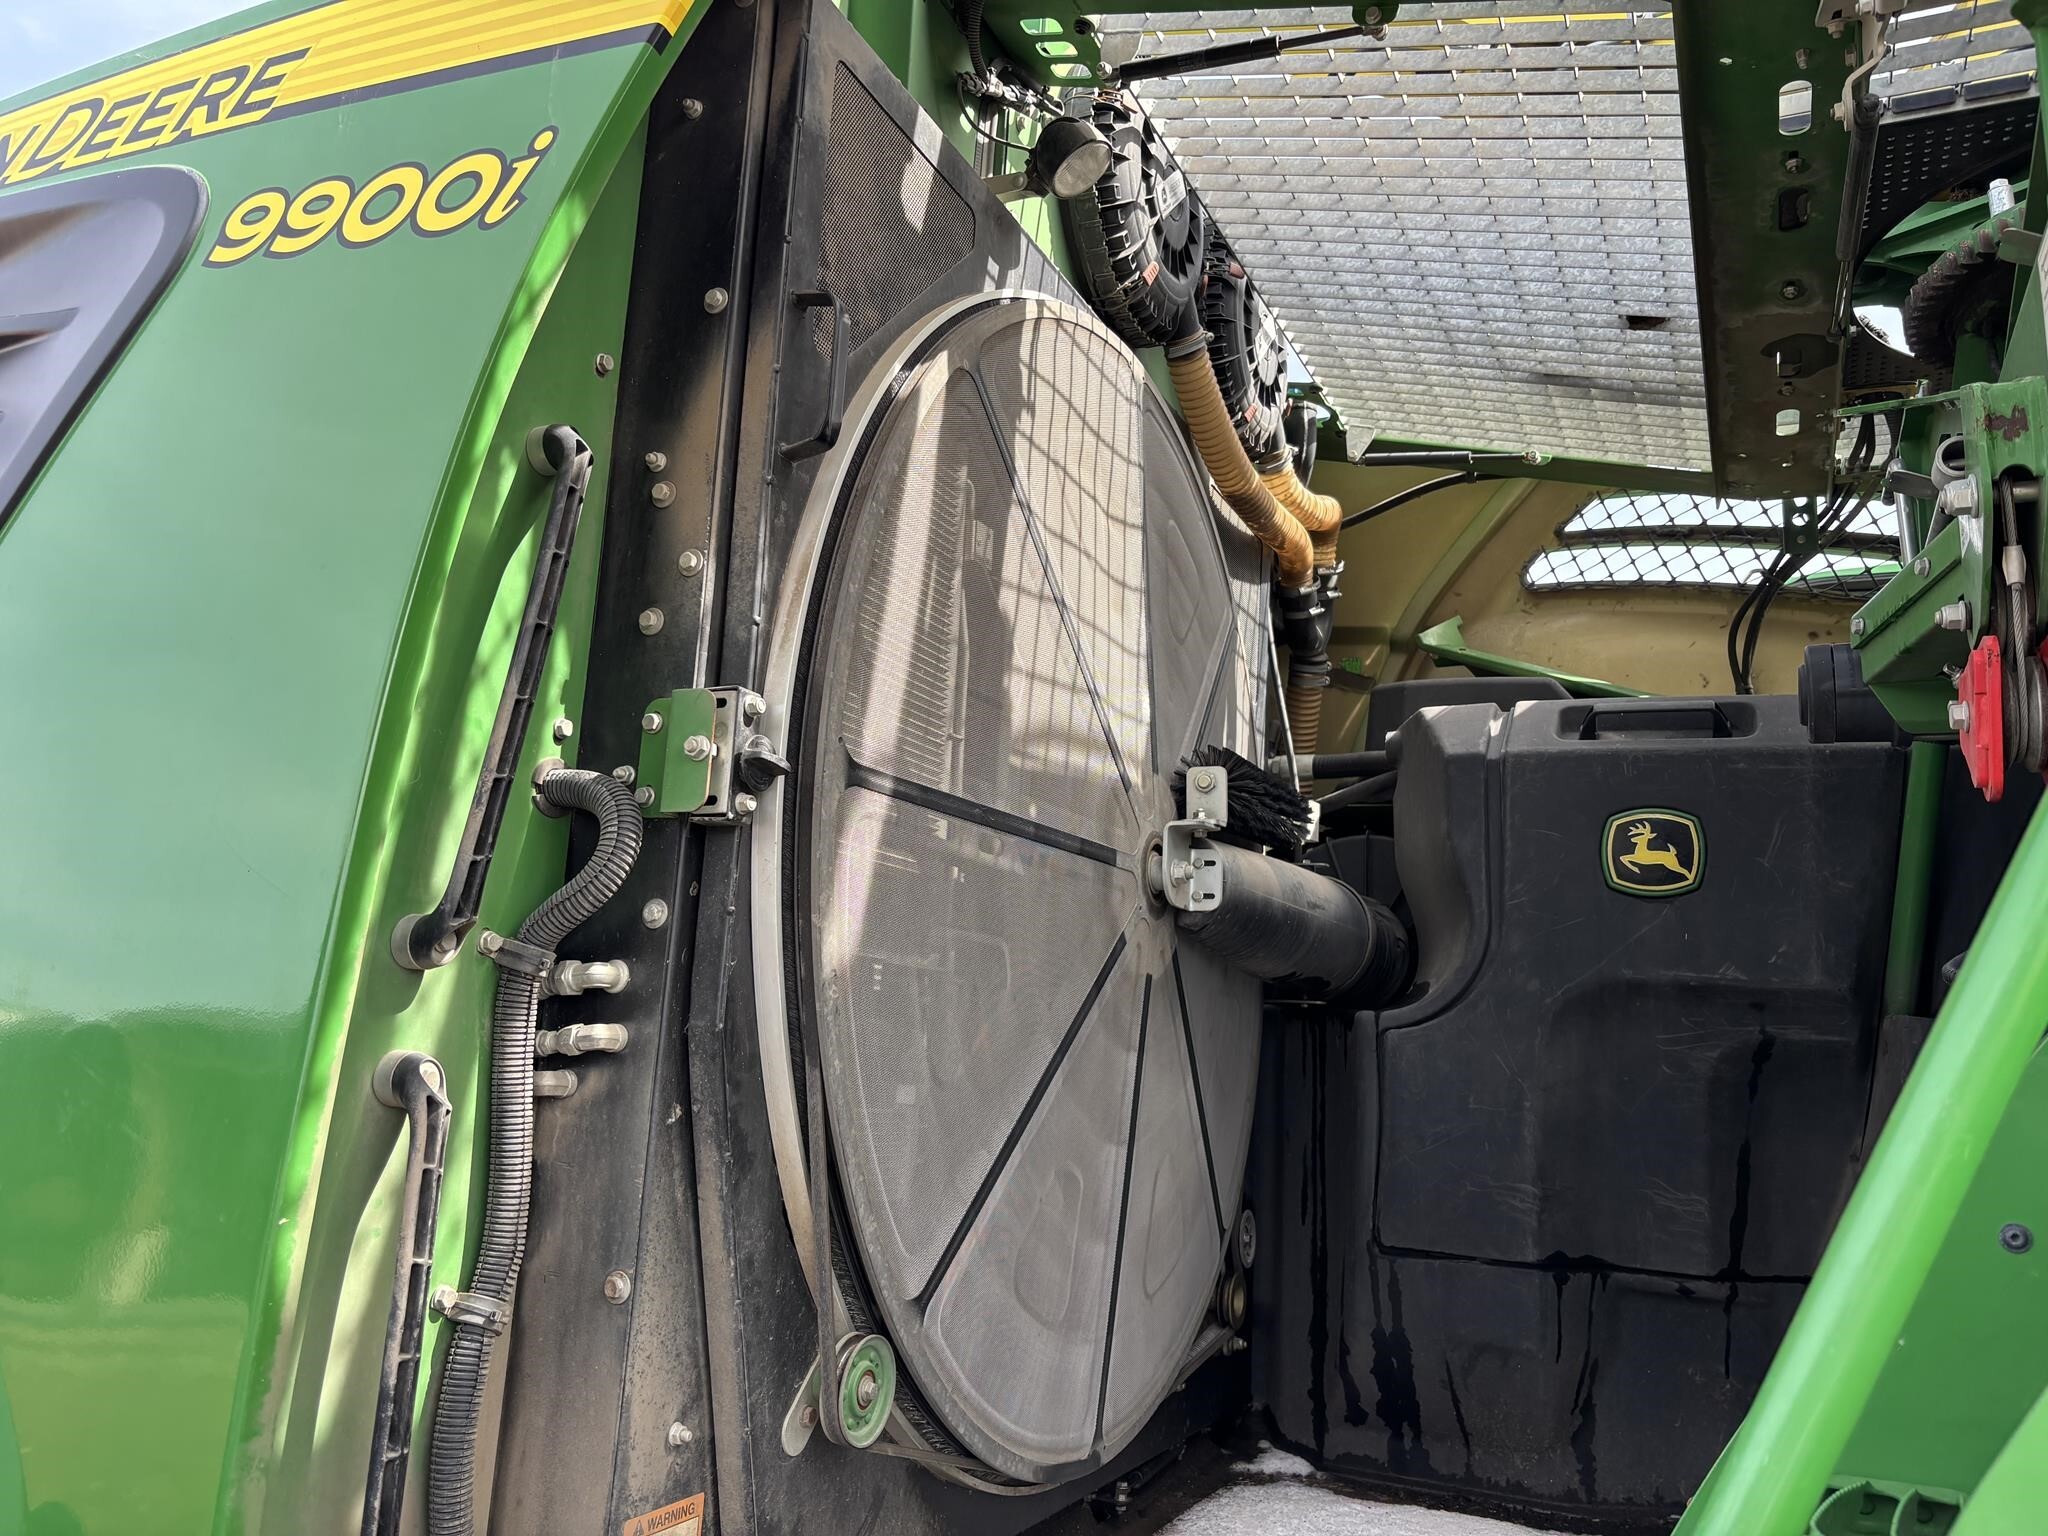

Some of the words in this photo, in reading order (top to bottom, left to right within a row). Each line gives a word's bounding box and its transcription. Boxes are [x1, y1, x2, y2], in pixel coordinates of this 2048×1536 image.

[19, 46, 312, 172] DEERE
[203, 127, 558, 267] 9900i
[648, 1502, 696, 1531] WARNING
